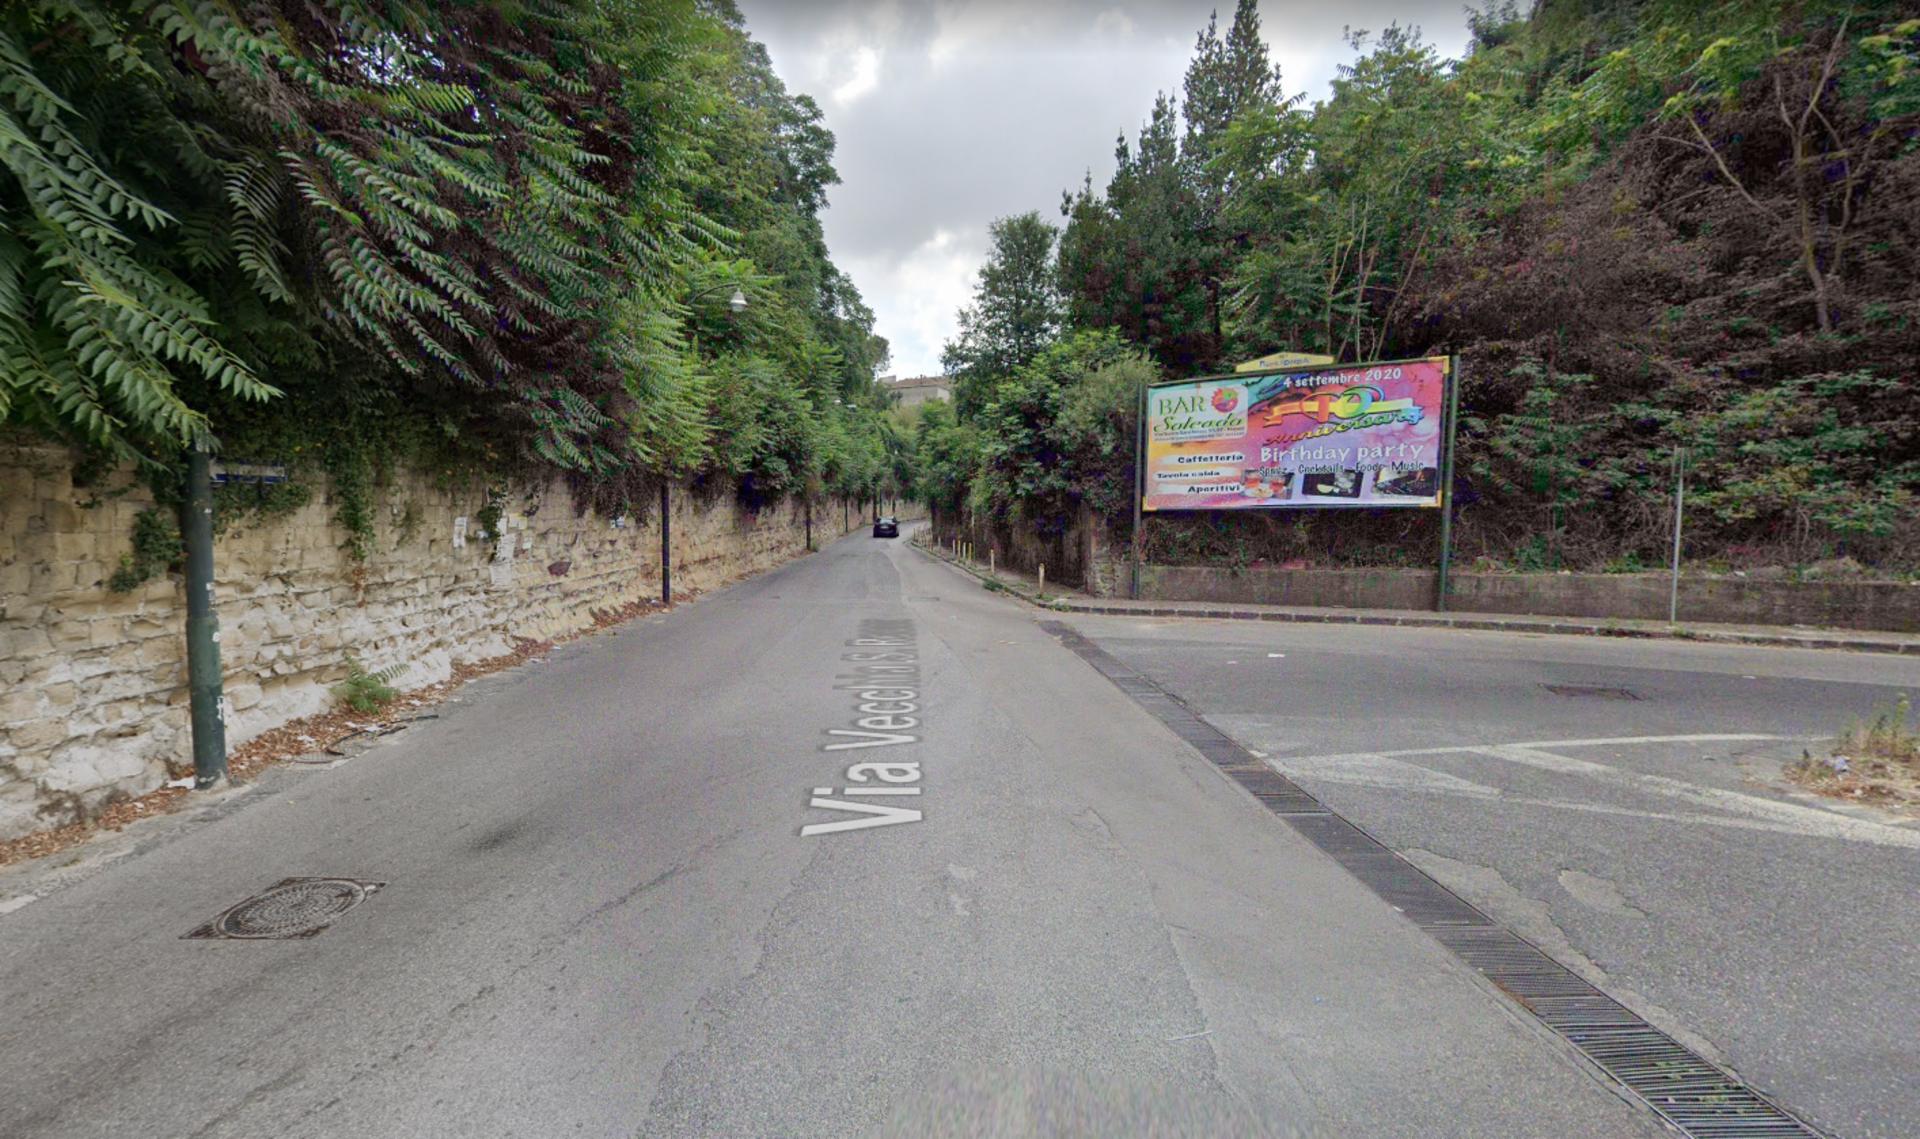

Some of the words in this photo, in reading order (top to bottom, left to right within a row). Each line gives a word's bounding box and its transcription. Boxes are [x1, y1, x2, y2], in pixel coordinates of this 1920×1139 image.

[1295, 373, 1362, 387] settembre
[1365, 367, 1402, 381] 2020
[1160, 396, 1207, 416] BAR
[1177, 454, 1243, 463] Caffetteria
[1260, 445, 1350, 463] Birthday
[1357, 443, 1425, 462] party
[1391, 460, 1425, 472] Music
[1187, 484, 1240, 494] Aperitivi
